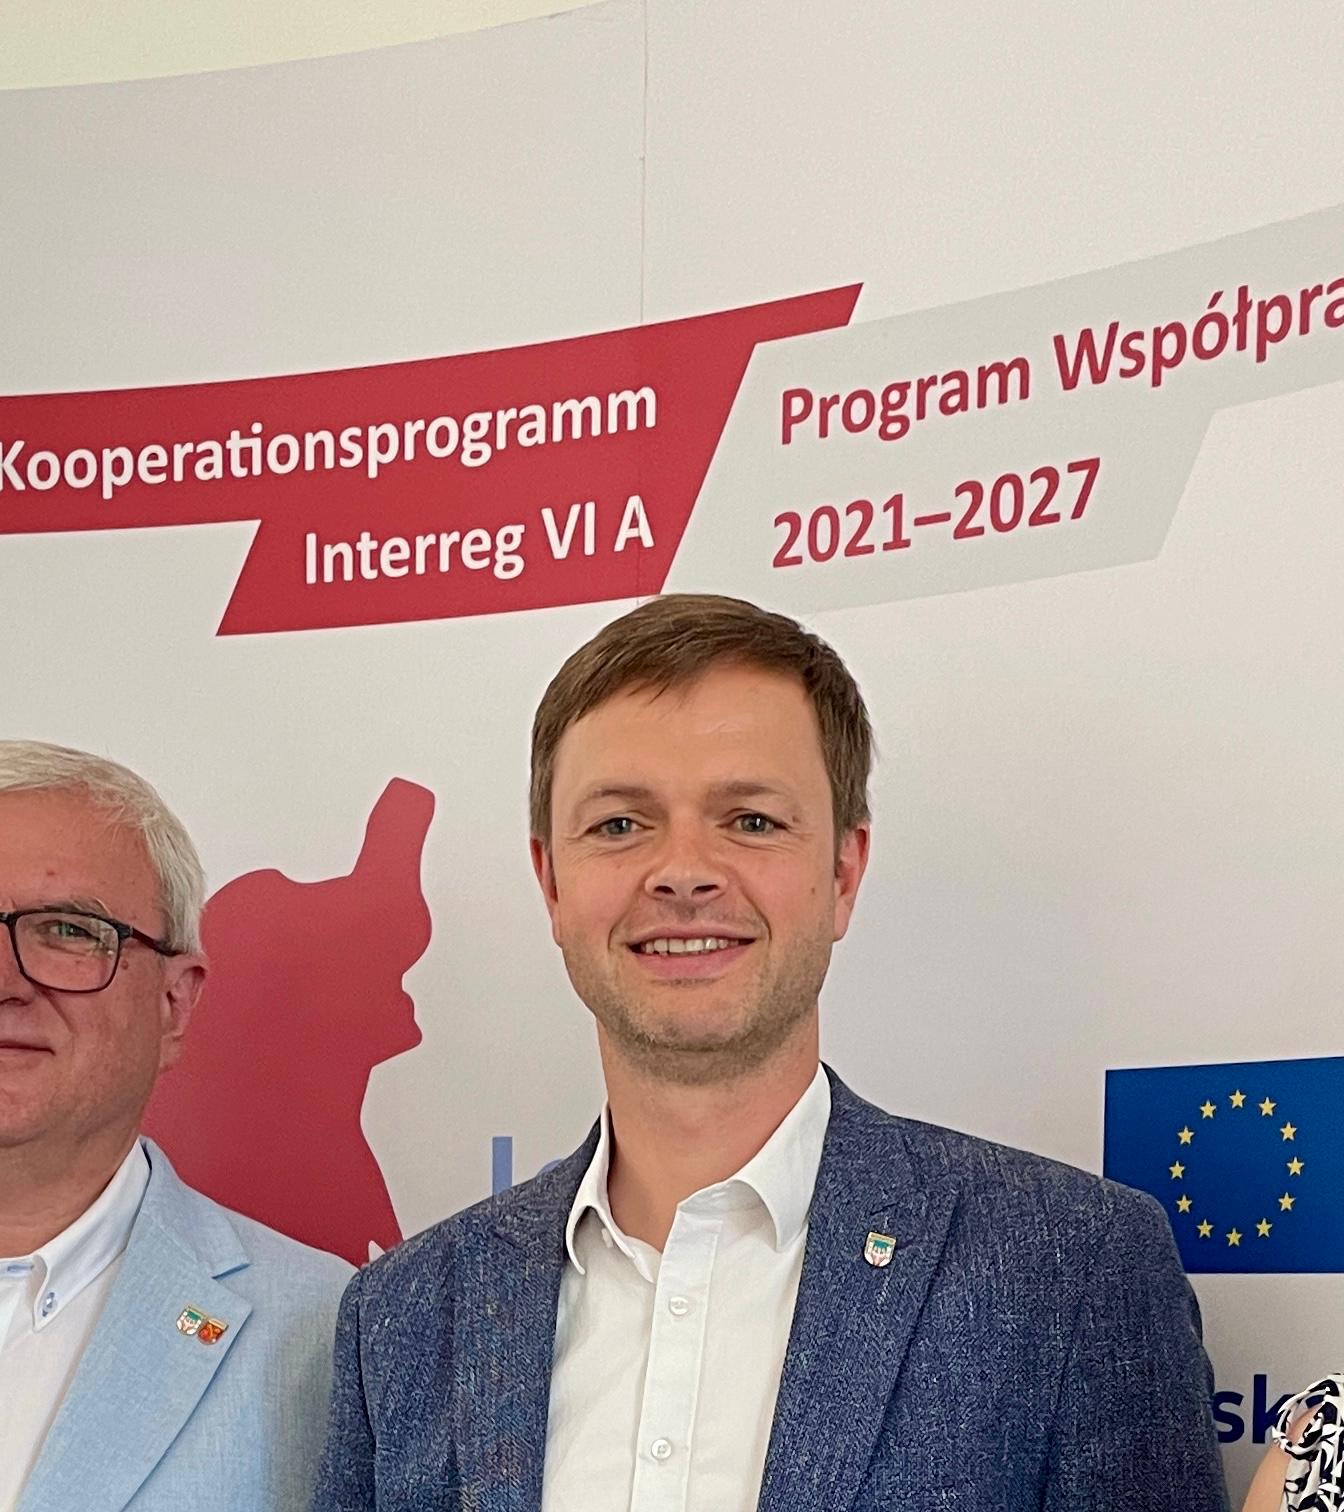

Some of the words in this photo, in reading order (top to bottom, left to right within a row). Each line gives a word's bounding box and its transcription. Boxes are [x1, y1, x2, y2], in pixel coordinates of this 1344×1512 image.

[779, 356, 1031, 446] Program
[304, 522, 525, 584] Interreg
[540, 501, 596, 560] VI
[613, 494, 655, 553] A
[772, 456, 1101, 569] 2021–2027
